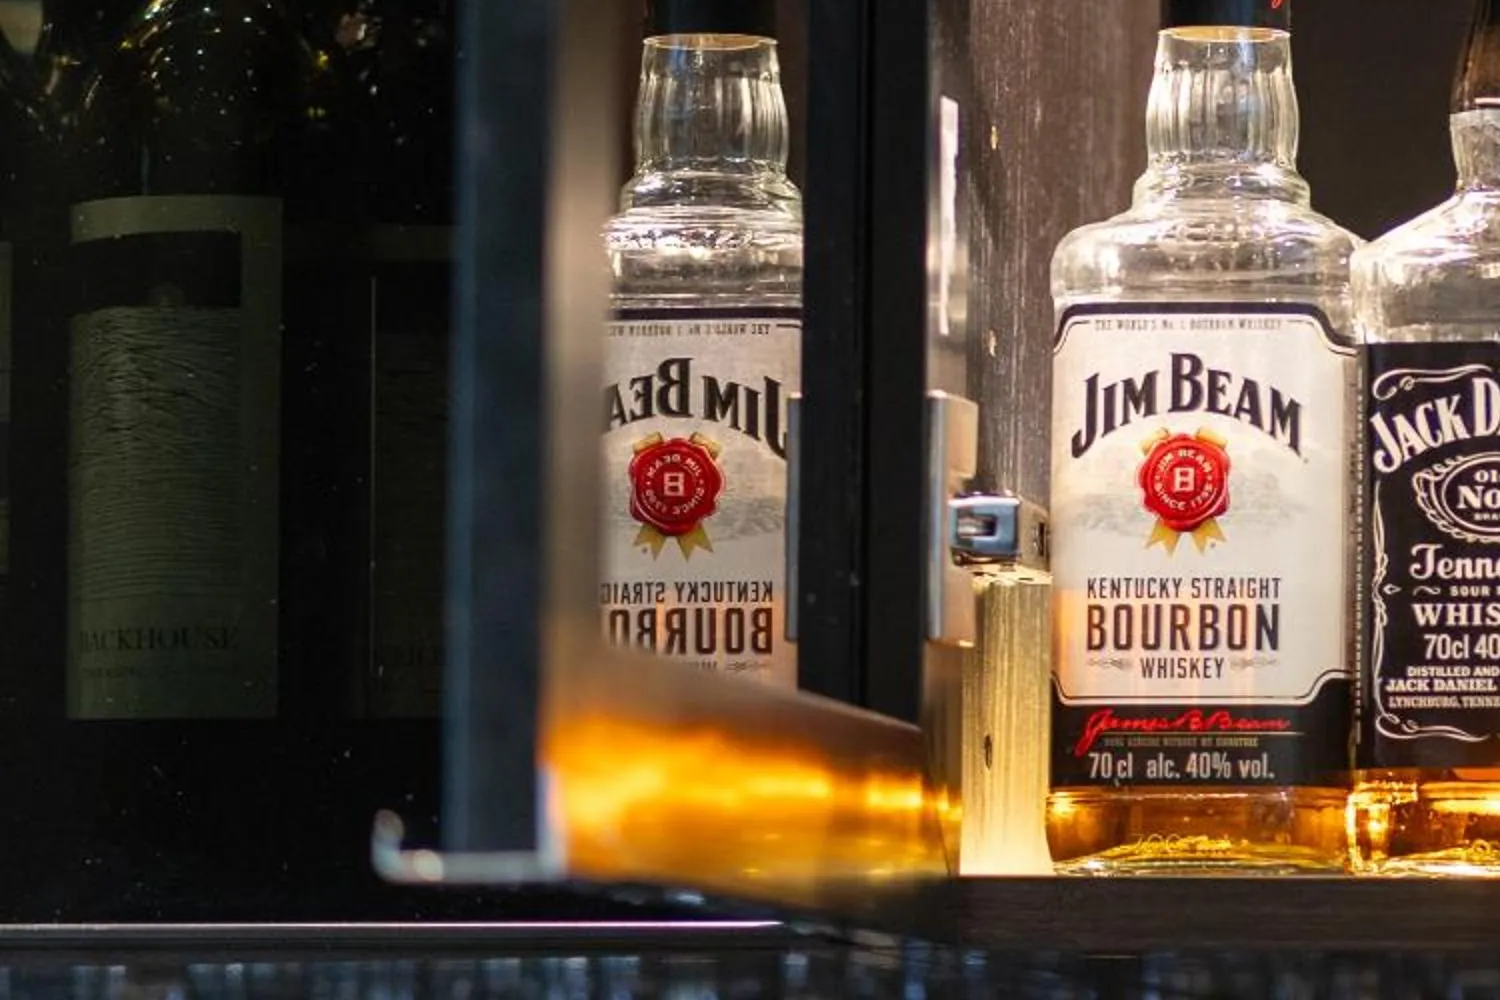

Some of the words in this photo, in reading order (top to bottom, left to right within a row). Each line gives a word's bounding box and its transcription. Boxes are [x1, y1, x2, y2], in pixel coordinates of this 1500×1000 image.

[1071, 370, 1159, 459] JIM
[1168, 352, 1304, 458] BEAM
[1369, 393, 1471, 474] JACK
[1087, 577, 1183, 599] KENTUCKY
[1191, 577, 1282, 599] STRAIGHT
[1451, 586, 1490, 597] SOUR
[1087, 603, 1280, 651] BOURBON
[1423, 633, 1470, 660] 70cl
[1140, 657, 1225, 680] WHISKEY
[1407, 665, 1471, 677] DISTILLED
[1473, 665, 1500, 677] AND
[1386, 678, 1430, 693] JACK
[1433, 678, 1497, 693] DANIEL
[1147, 752, 1181, 779] alc.
[1186, 751, 1232, 779] 40%
[1238, 752, 1275, 779] vol.
